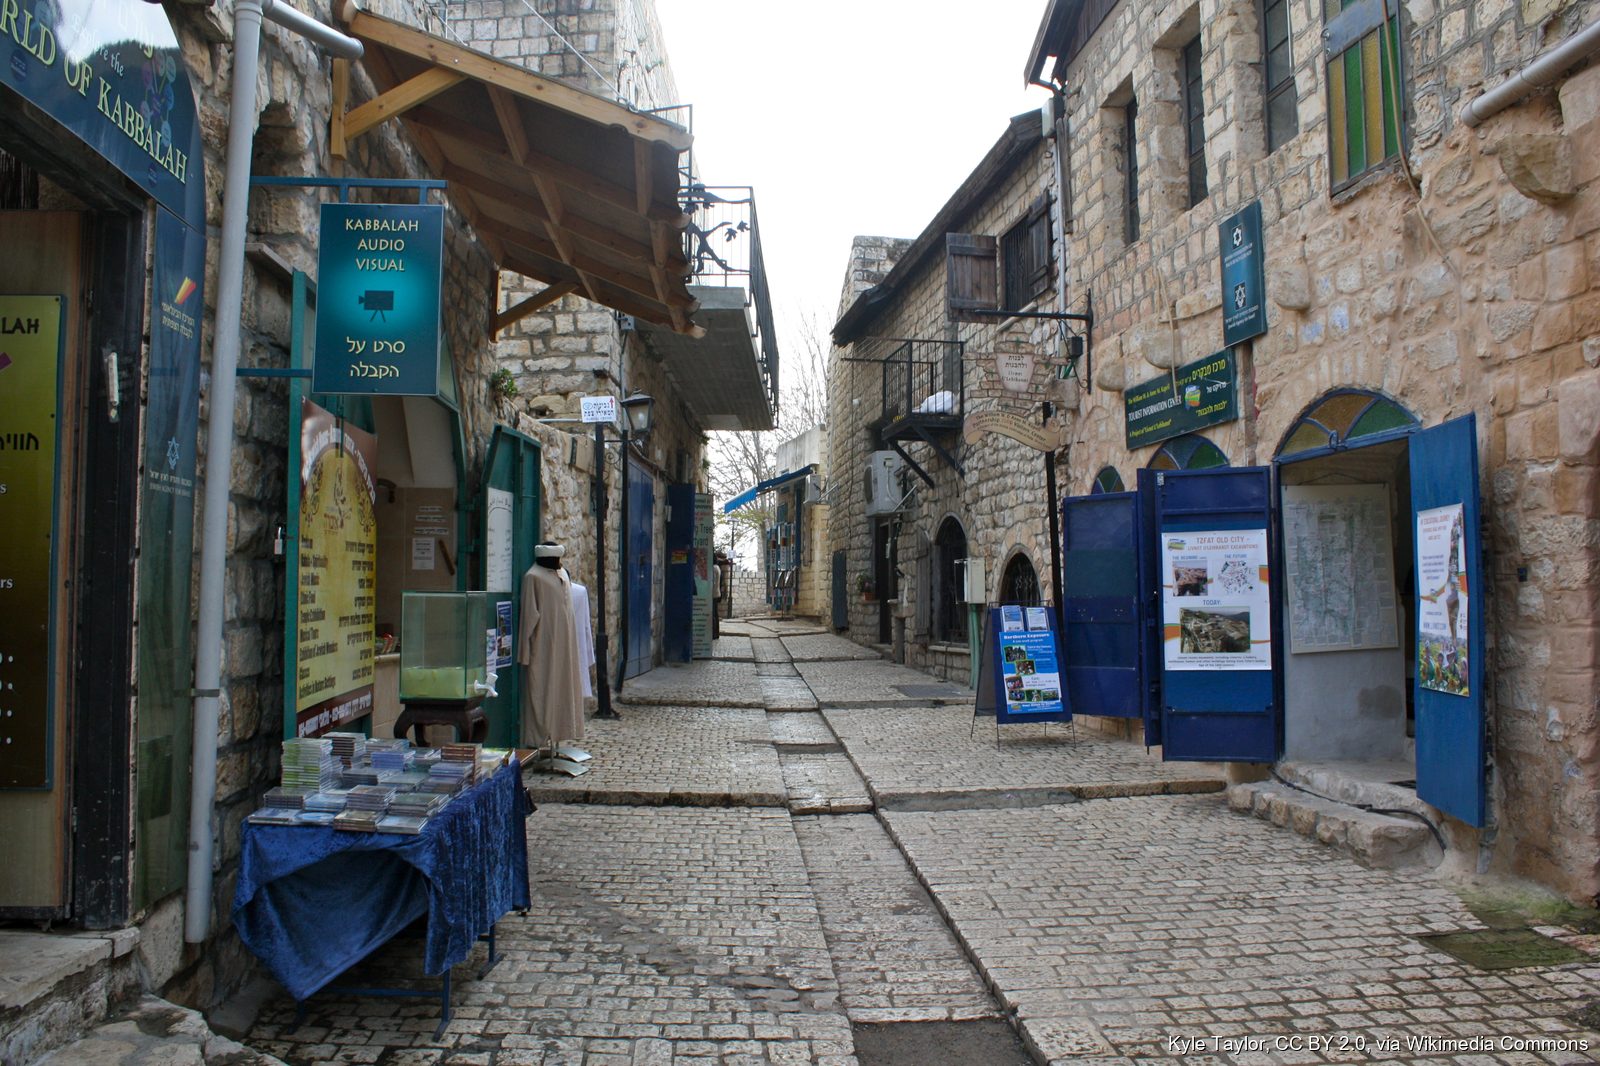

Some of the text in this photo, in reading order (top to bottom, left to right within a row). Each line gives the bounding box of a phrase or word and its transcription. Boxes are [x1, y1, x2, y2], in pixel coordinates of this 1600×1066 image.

[97, 76, 188, 185] KABBALAH
[345, 218, 419, 232] KABBALAH
[357, 238, 405, 252] AUDIO
[356, 258, 406, 272] VISUAL
[346, 336, 406, 354] סרט על
[350, 361, 400, 379] הקבלה
[1213, 360, 1226, 373] מרכז
[1128, 410, 1142, 422] TOURIST
[1142, 402, 1168, 418] INFORMATION
